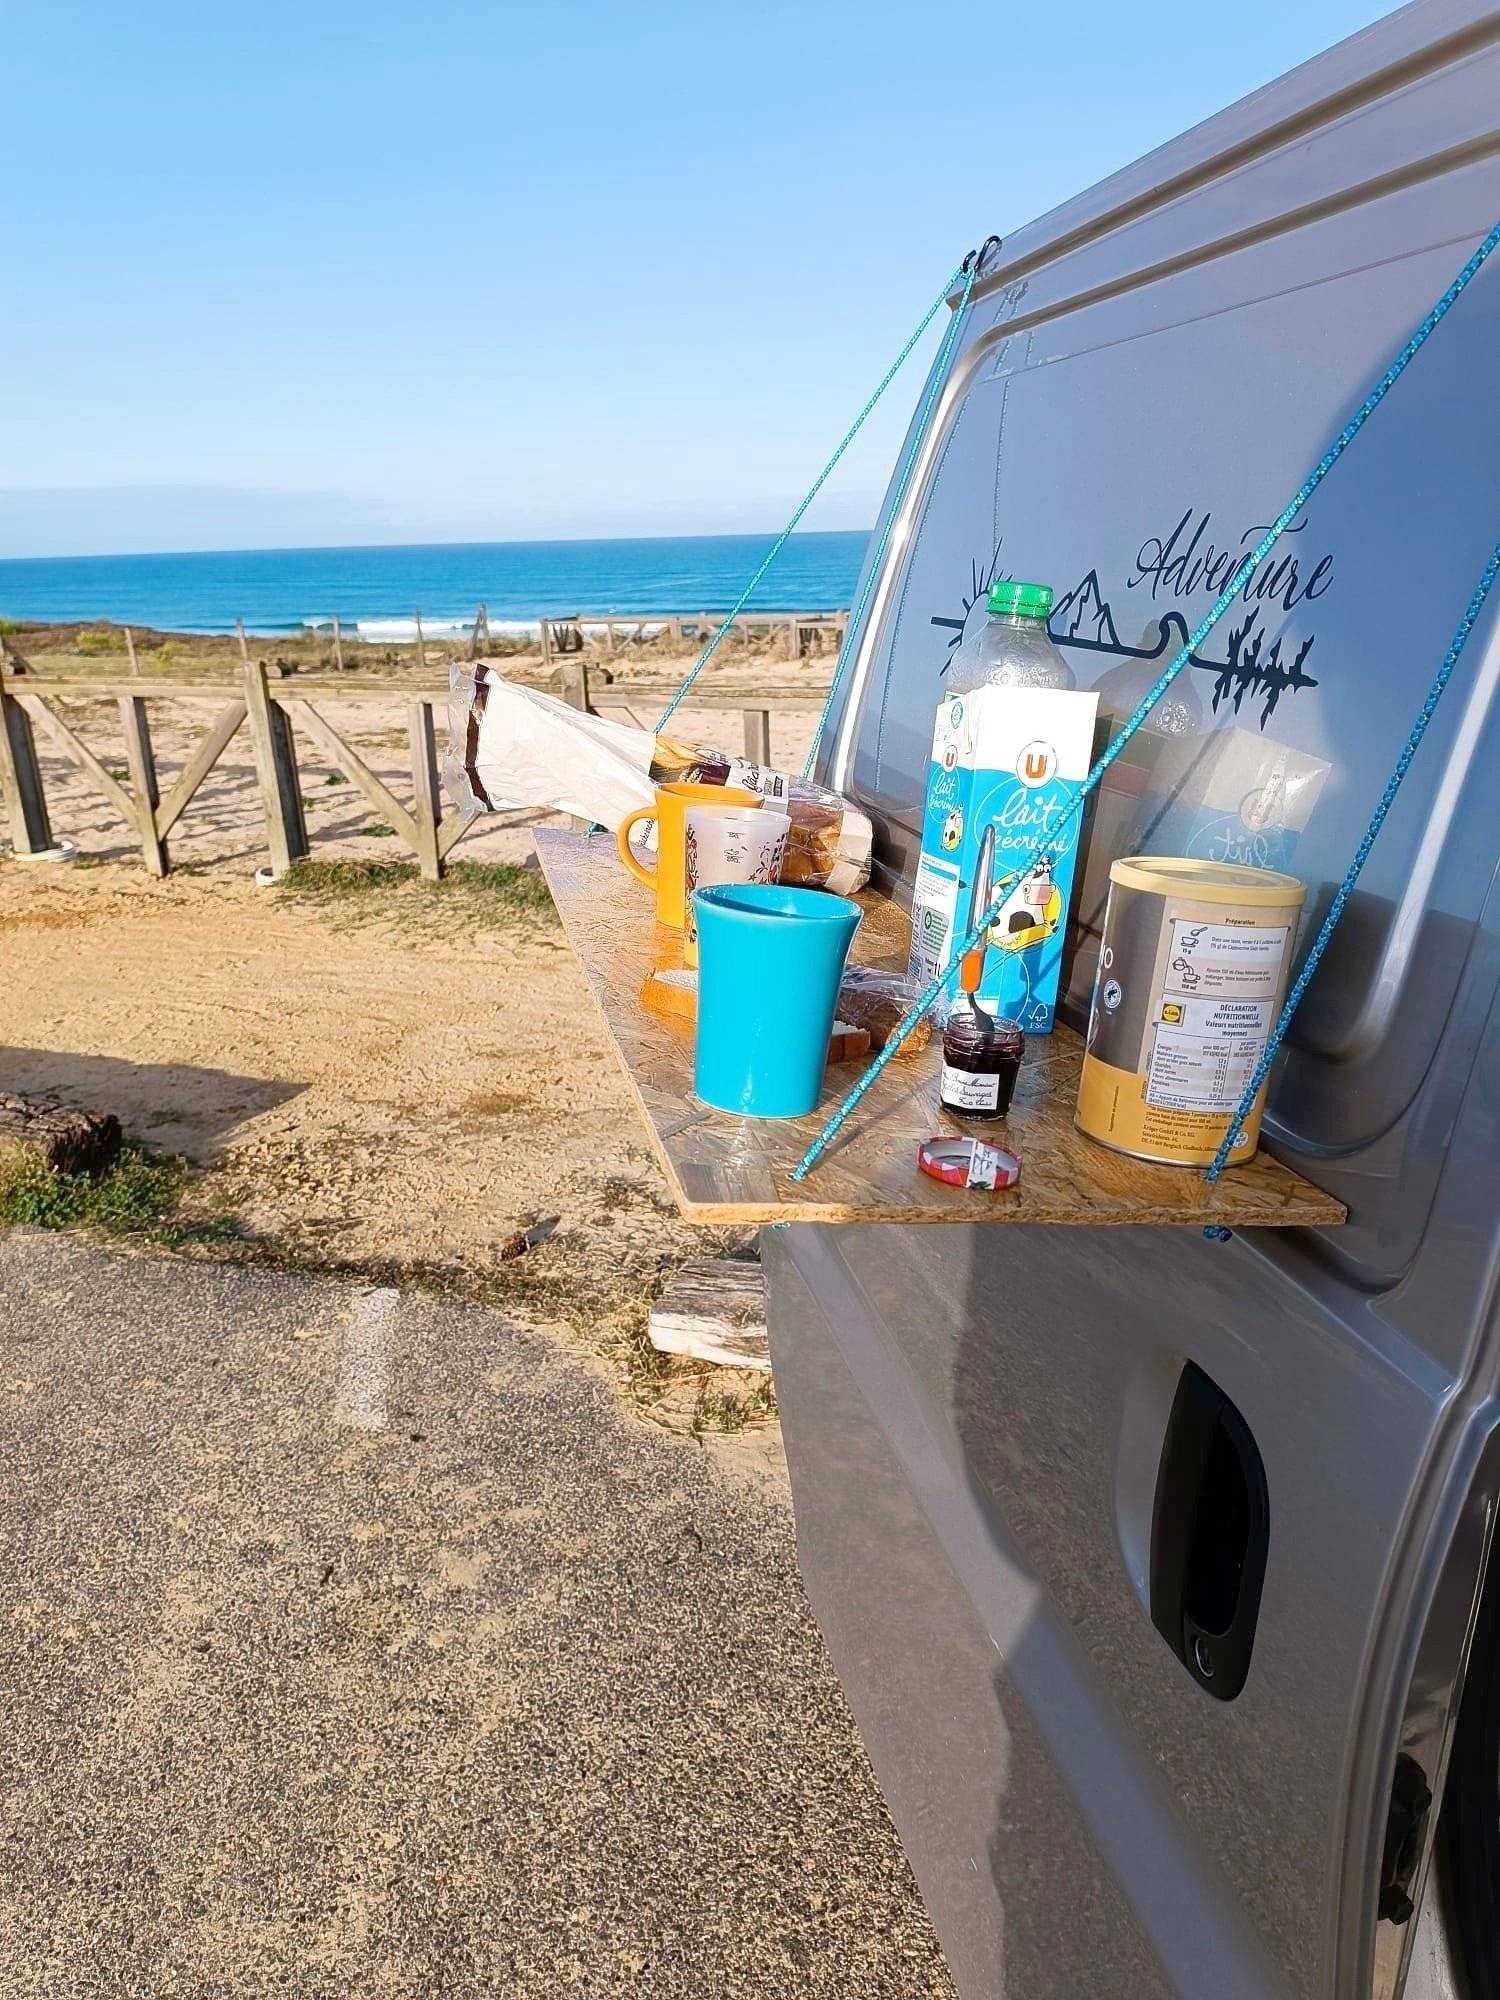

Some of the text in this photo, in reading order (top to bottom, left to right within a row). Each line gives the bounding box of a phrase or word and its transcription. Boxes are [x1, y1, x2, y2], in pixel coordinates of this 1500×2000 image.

[1127, 508, 1334, 611] Adventure
[1026, 753, 1048, 778] U
[934, 772, 955, 800] lait
[992, 787, 1063, 833] lait
[1225, 918, 1255, 926] Préparation
[1030, 1021, 1046, 1029] FSC
